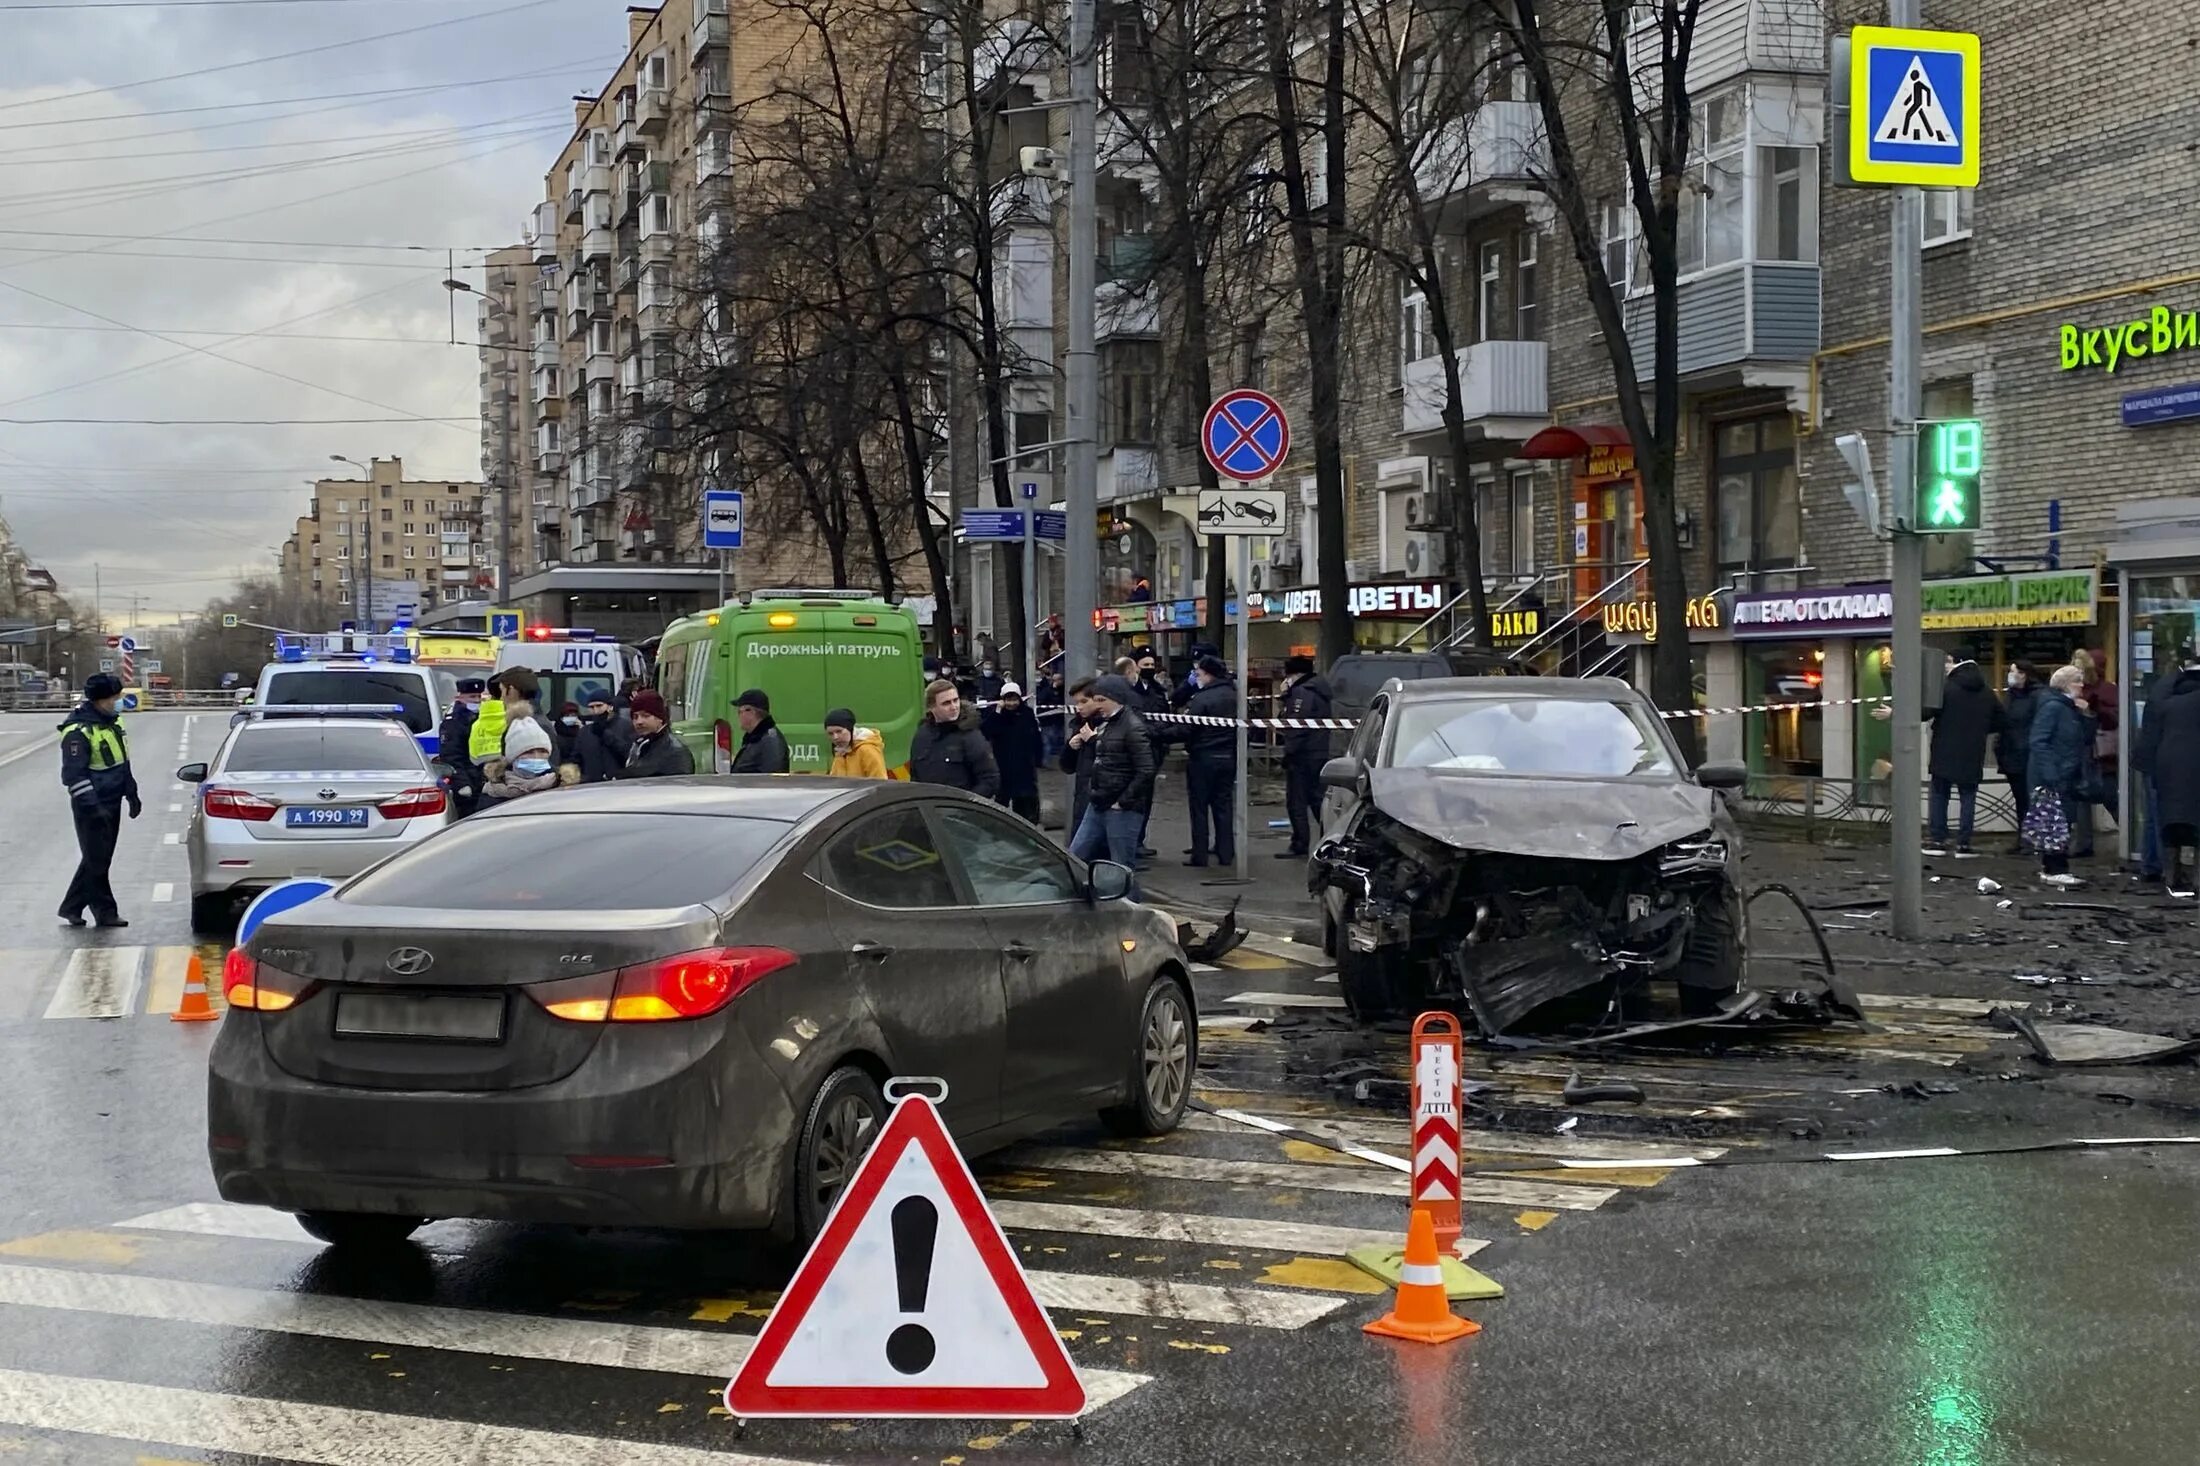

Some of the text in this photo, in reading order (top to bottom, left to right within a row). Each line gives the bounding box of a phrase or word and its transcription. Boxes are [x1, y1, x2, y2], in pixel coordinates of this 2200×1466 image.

[2060, 305, 2200, 373] ВкусВи
[1937, 423, 1981, 476] 18
[2016, 575, 2090, 610] ДВОРИК
[560, 649, 609, 671] ДПС
[746, 642, 901, 659] Дорожный патруль
[309, 810, 343, 823] 1990
[350, 809, 363, 822] 99
[559, 954, 593, 964] GLS
[1432, 1045, 1443, 1098] МЕСТО
[1421, 1103, 1451, 1115] ДТП
